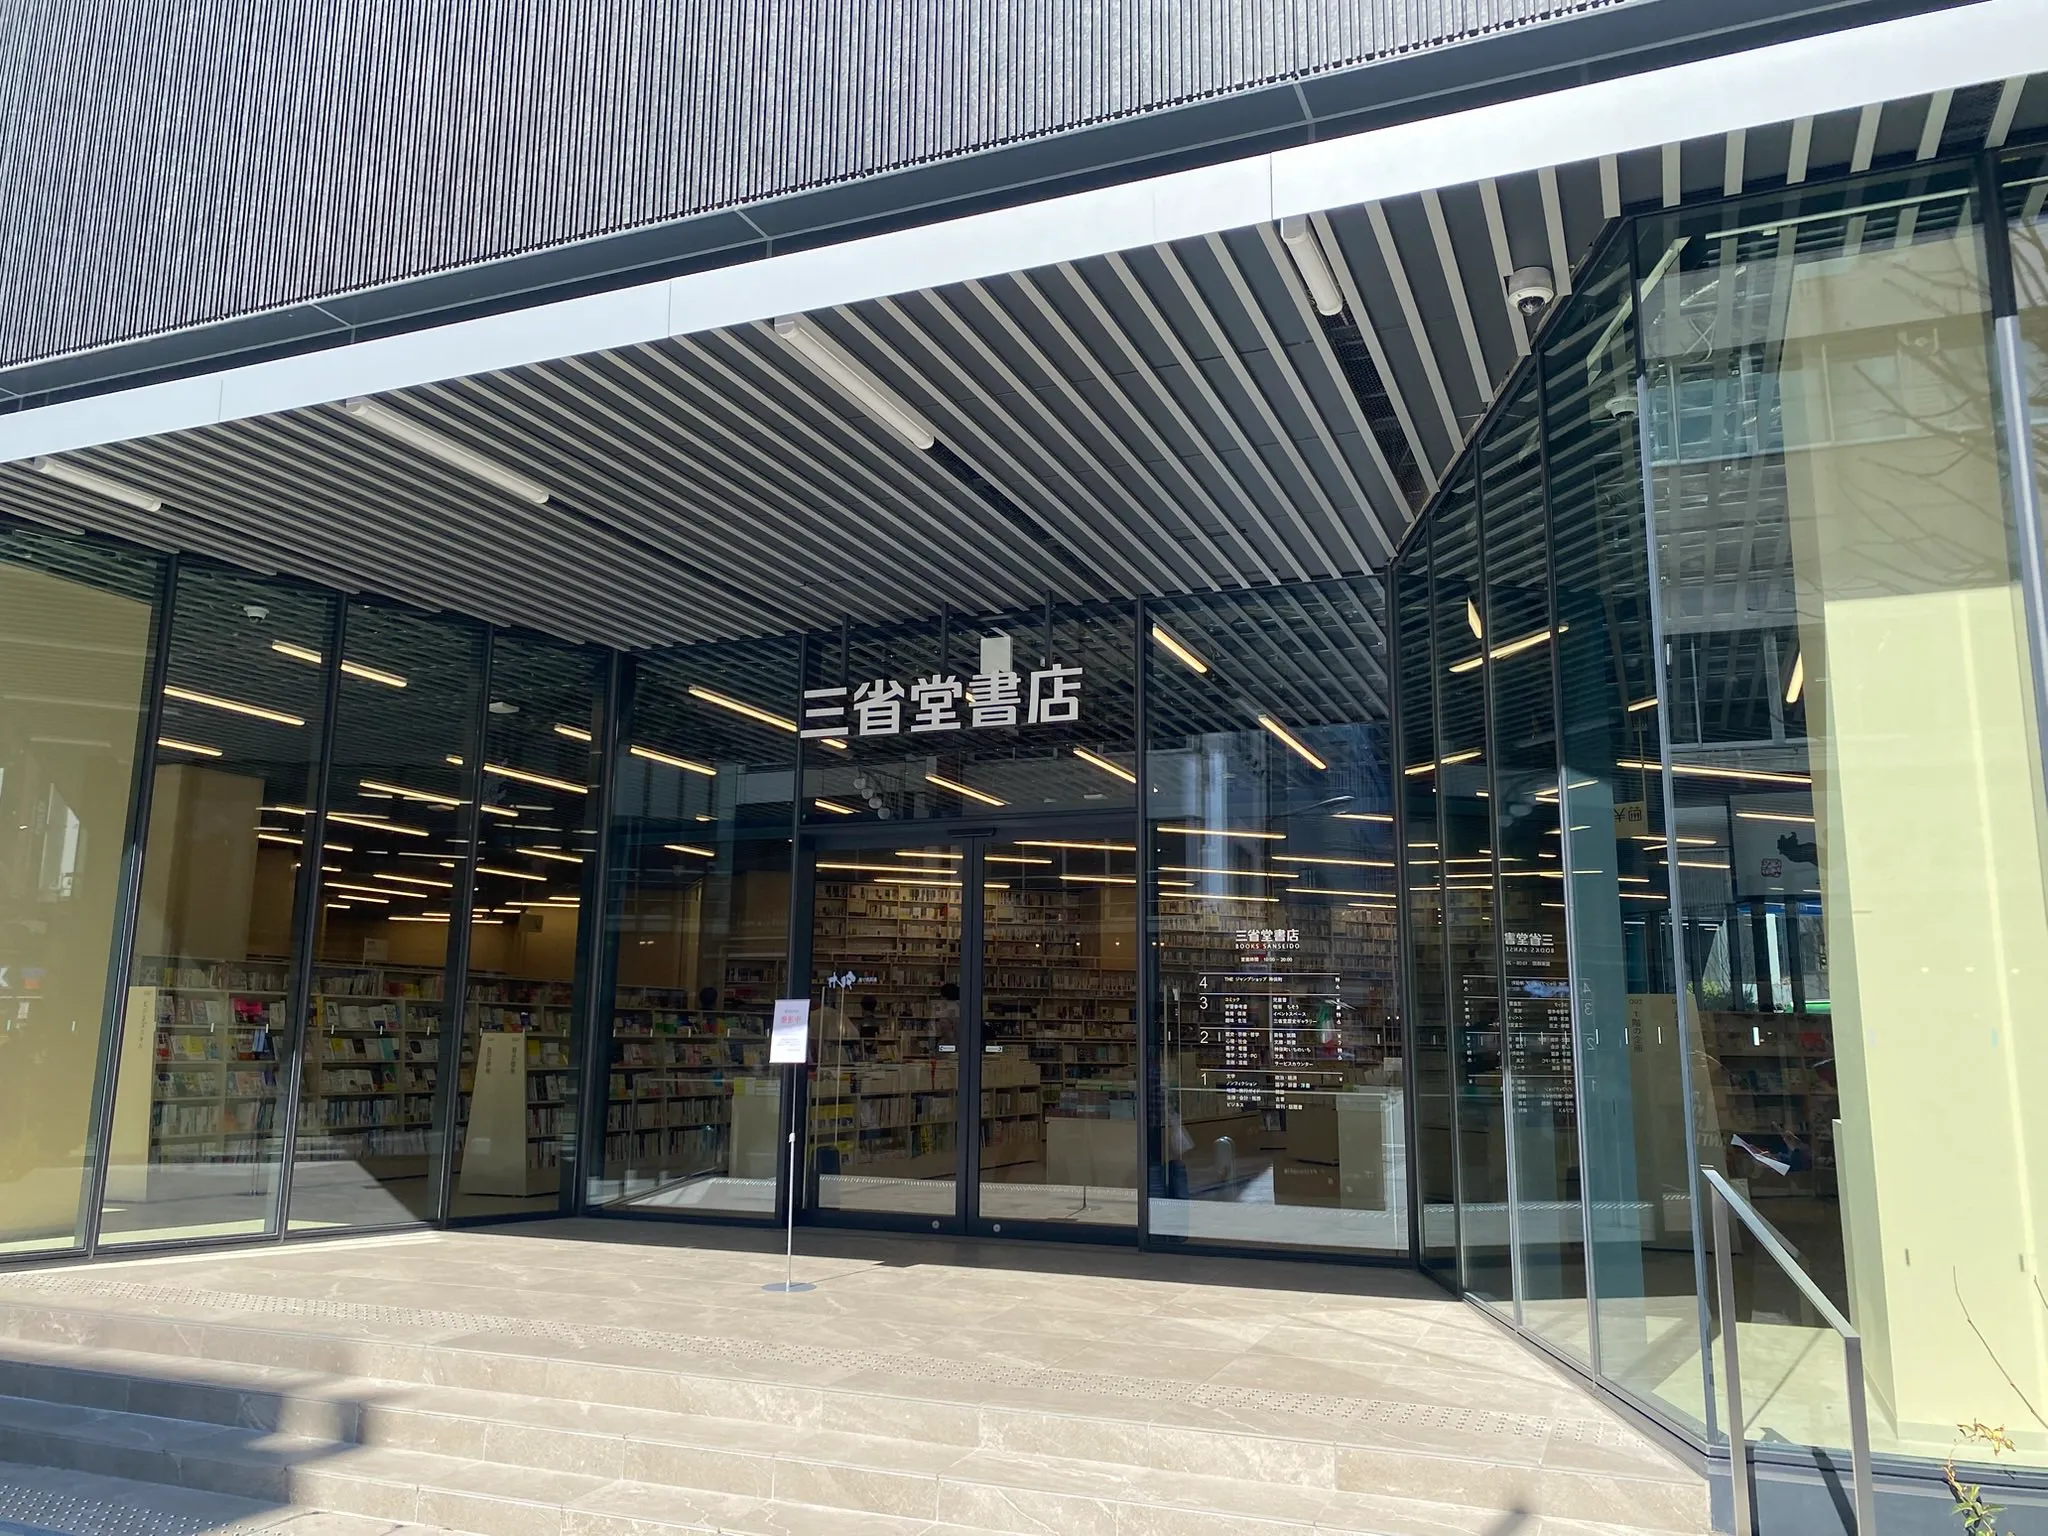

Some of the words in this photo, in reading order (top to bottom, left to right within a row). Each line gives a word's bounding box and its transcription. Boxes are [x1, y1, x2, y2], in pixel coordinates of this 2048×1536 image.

[800, 664, 1083, 738] 三省堂書店
[1235, 928, 1299, 942] 三省堂書店
[1199, 976, 1208, 989] 4
[1199, 996, 1208, 1010] 3
[1200, 1030, 1209, 1044] 2
[1201, 1072, 1207, 1086] 1
